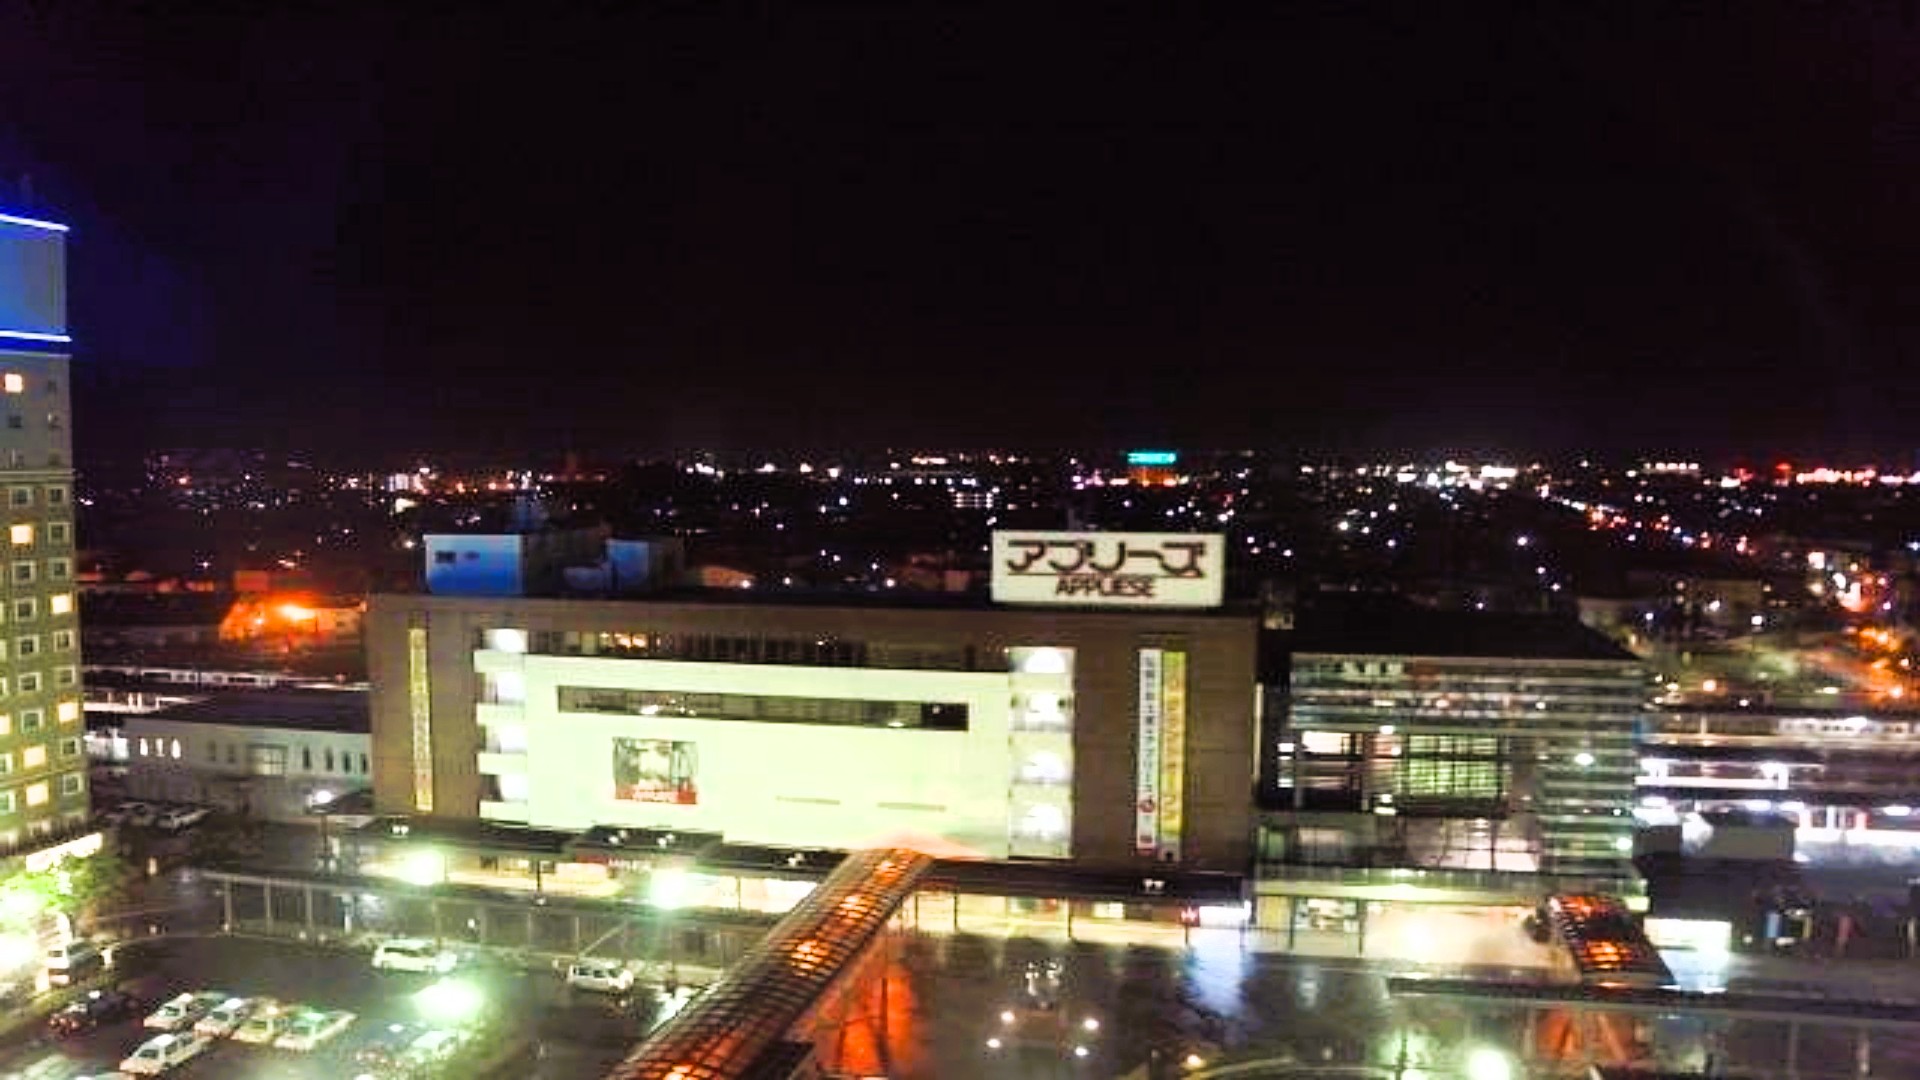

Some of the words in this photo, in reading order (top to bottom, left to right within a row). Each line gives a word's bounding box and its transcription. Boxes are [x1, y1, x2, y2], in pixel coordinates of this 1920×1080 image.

[1006, 539, 1206, 577] アプリーズ
